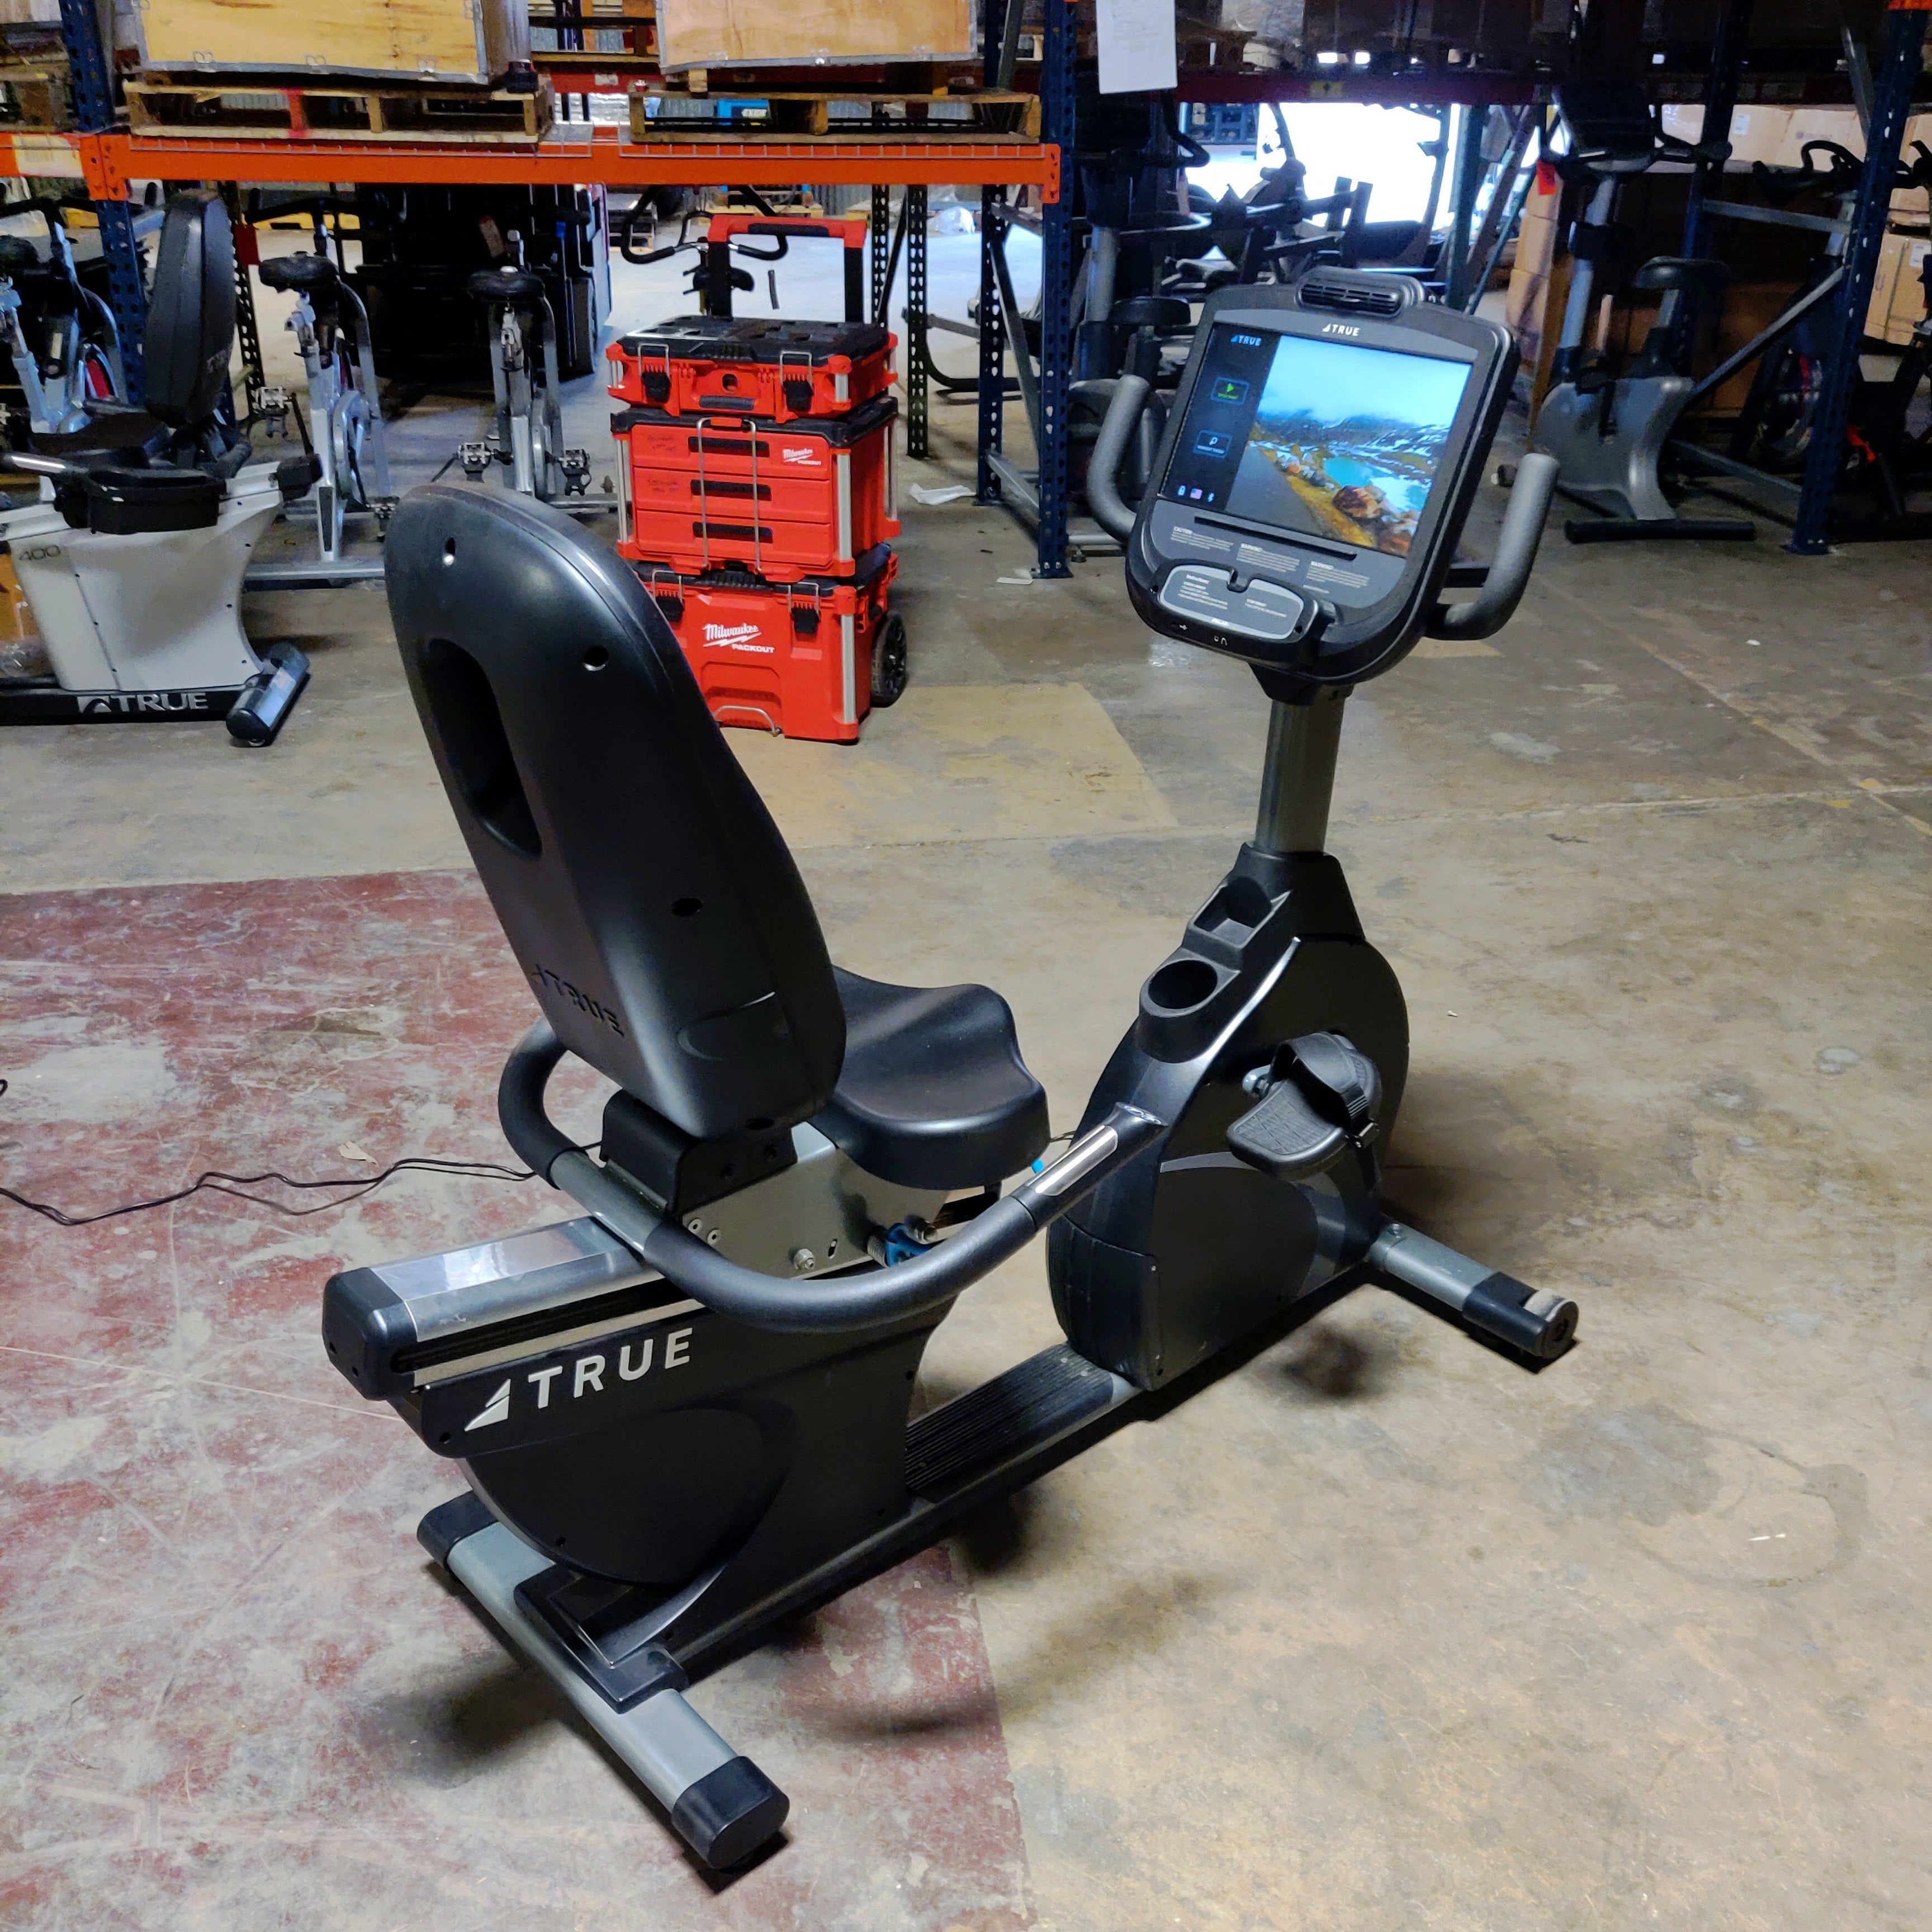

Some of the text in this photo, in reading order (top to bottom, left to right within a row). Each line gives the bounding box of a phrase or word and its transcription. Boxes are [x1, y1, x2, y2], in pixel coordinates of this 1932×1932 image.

[1331, 324, 1361, 337] TRUE
[1238, 335, 1262, 347] TRUE
[702, 623, 759, 641] Milwaukee
[731, 643, 775, 653] PACKOUT
[111, 692, 209, 712] TRUE
[545, 969, 624, 1038] TRUE
[527, 1327, 693, 1409] TRUE
